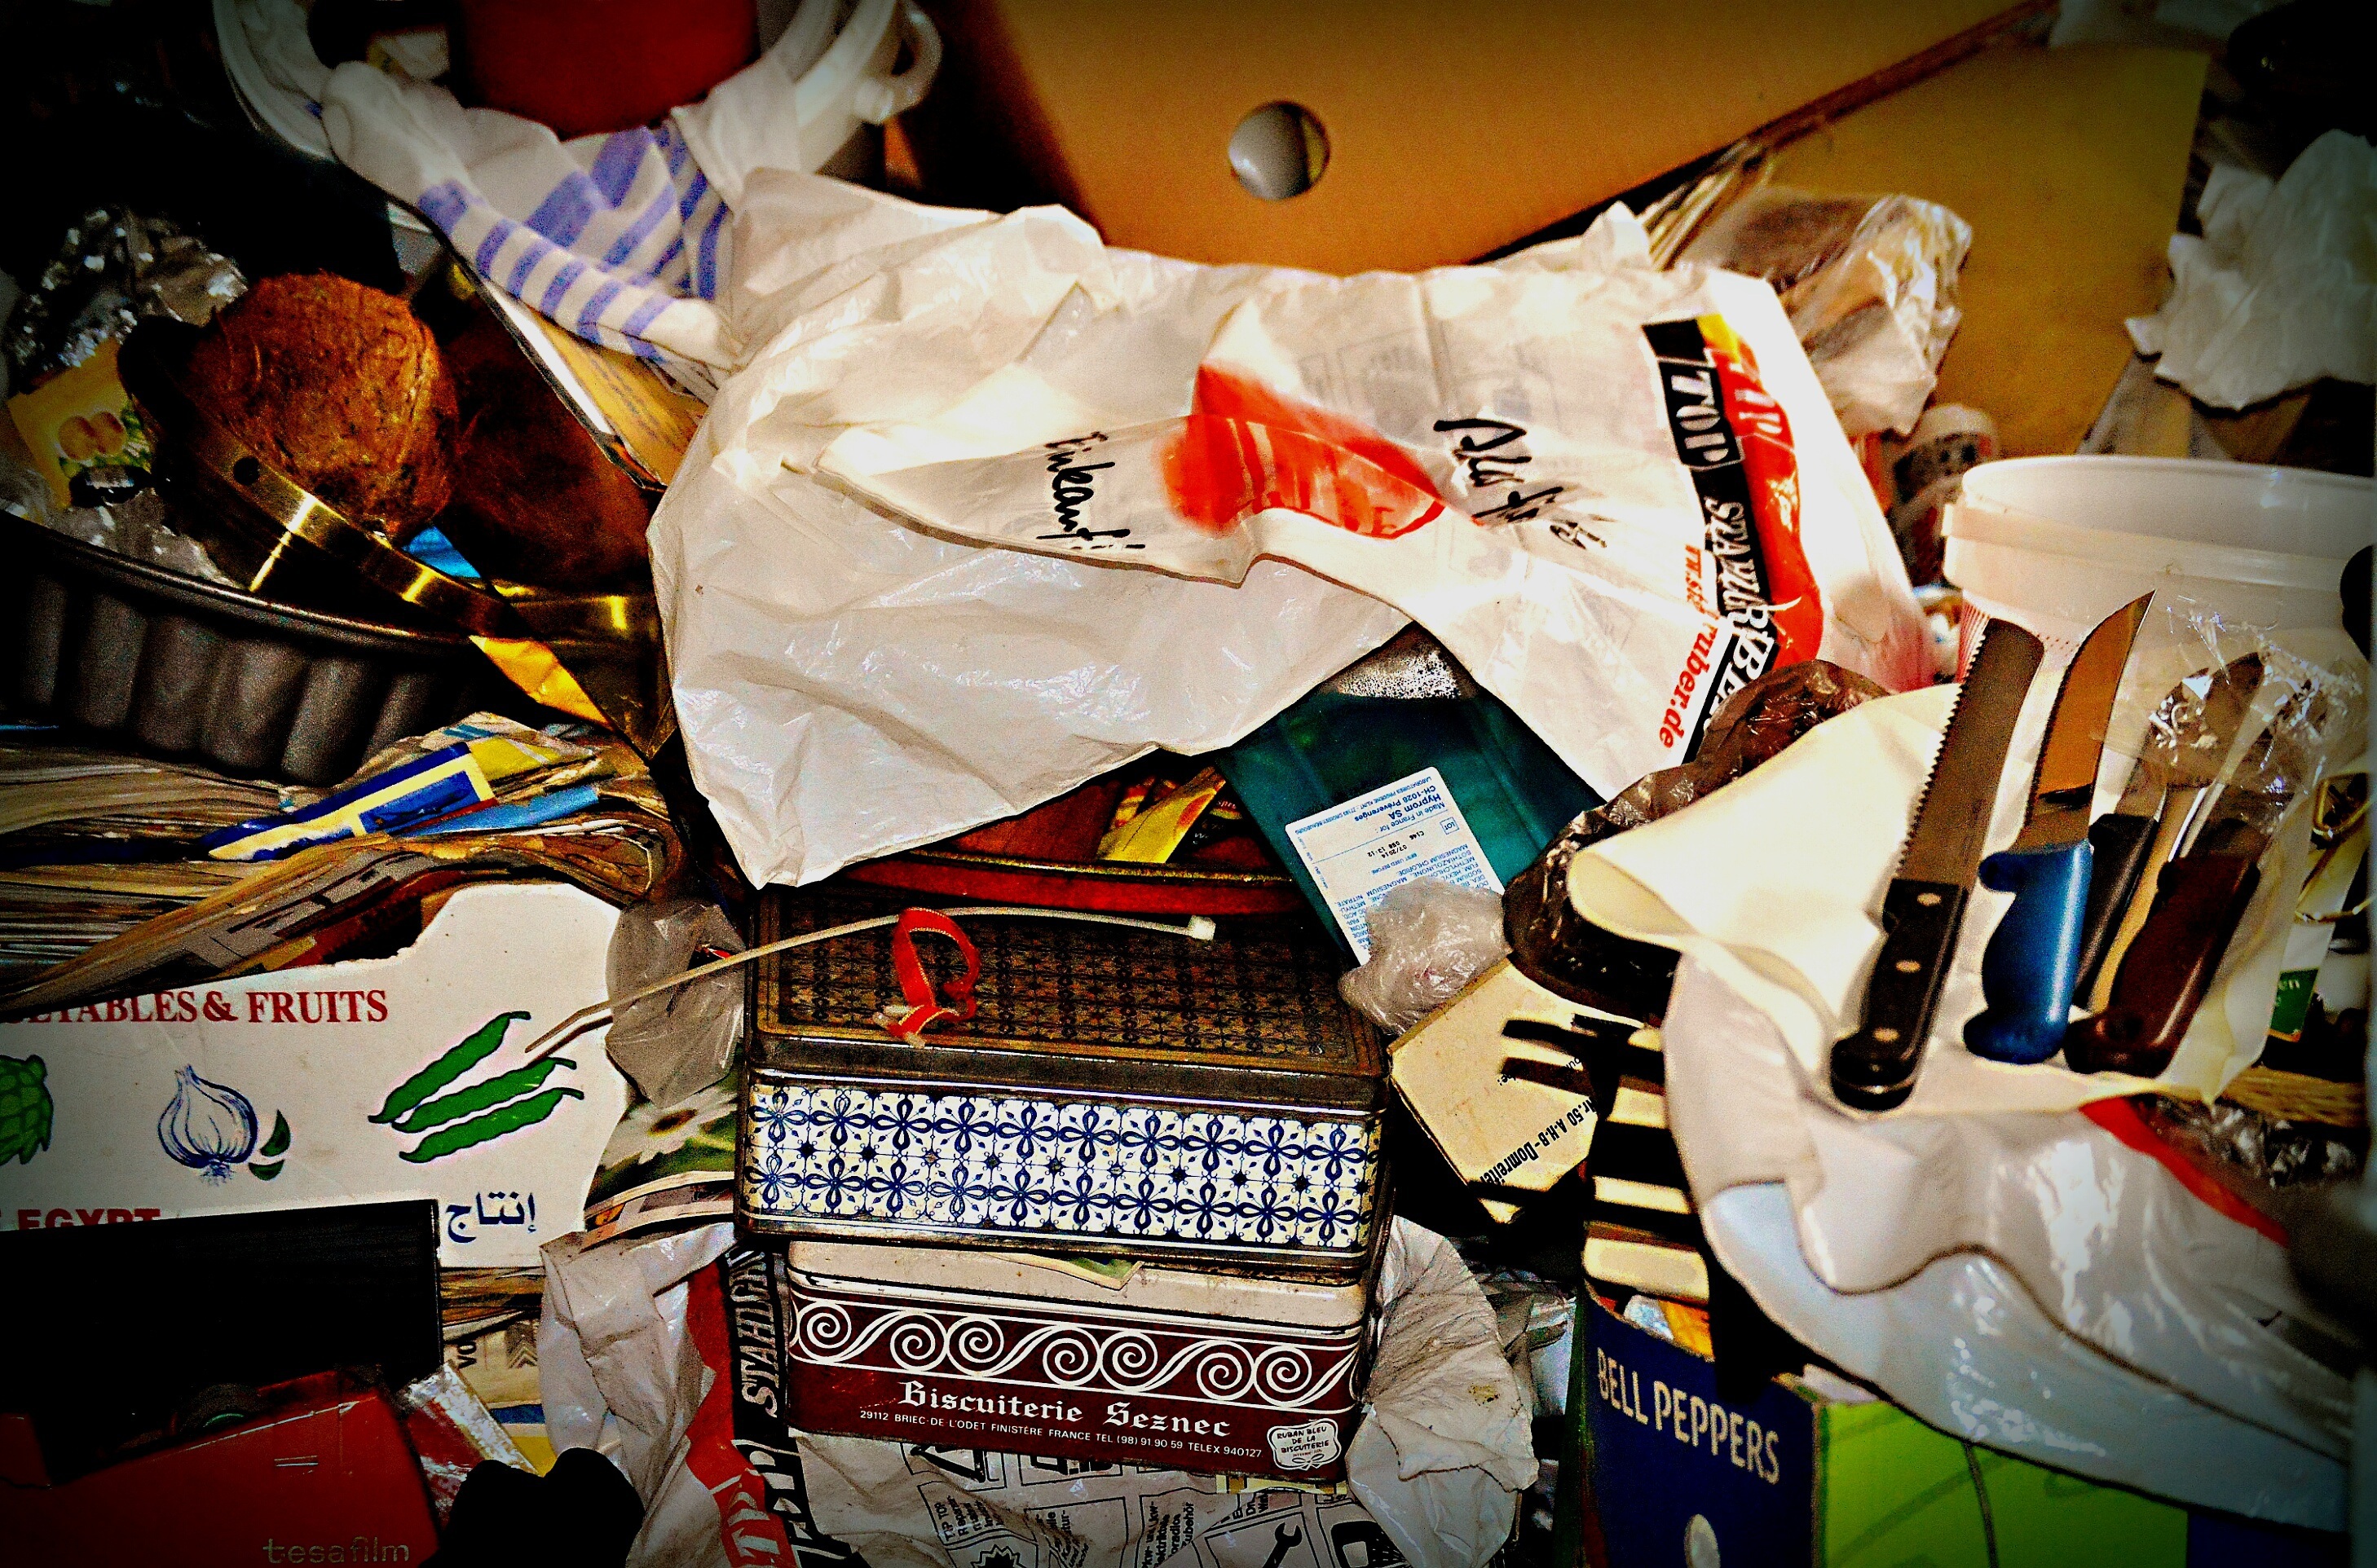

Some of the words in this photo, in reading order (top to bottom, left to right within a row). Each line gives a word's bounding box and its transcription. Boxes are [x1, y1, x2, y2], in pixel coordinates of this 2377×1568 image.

[1665, 366, 1731, 469] TOP
[1401, 784, 1435, 803] CH-1028
[1403, 791, 1440, 813] Hyprom
[1387, 808, 1402, 820] SA
[1424, 801, 1444, 813] Made
[1390, 813, 1414, 828] France
[1444, 821, 1455, 830] LOT
[202, 991, 236, 1022] &
[247, 990, 388, 1023] FRUITS
[446, 1191, 536, 1244] إنتاج
[895, 1378, 1085, 1422] Biscuiterie
[1103, 1400, 1232, 1437] Seznec
[1597, 1346, 1648, 1425] BELL
[1653, 1381, 1779, 1485] PEPPERS
[860, 1411, 889, 1421] 29112
[991, 1422, 1043, 1436] FINISTÈRE
[1048, 1428, 1091, 1441] FRANCE
[1116, 1434, 1137, 1446] (98)
[1188, 1442, 1220, 1453] TELEX
[1277, 1430, 1303, 1438] RUBAN
[1281, 1440, 1329, 1452] BISCUITERIE
[933, 1502, 948, 1519] TOP
[262, 1536, 409, 1564] tesafilm
